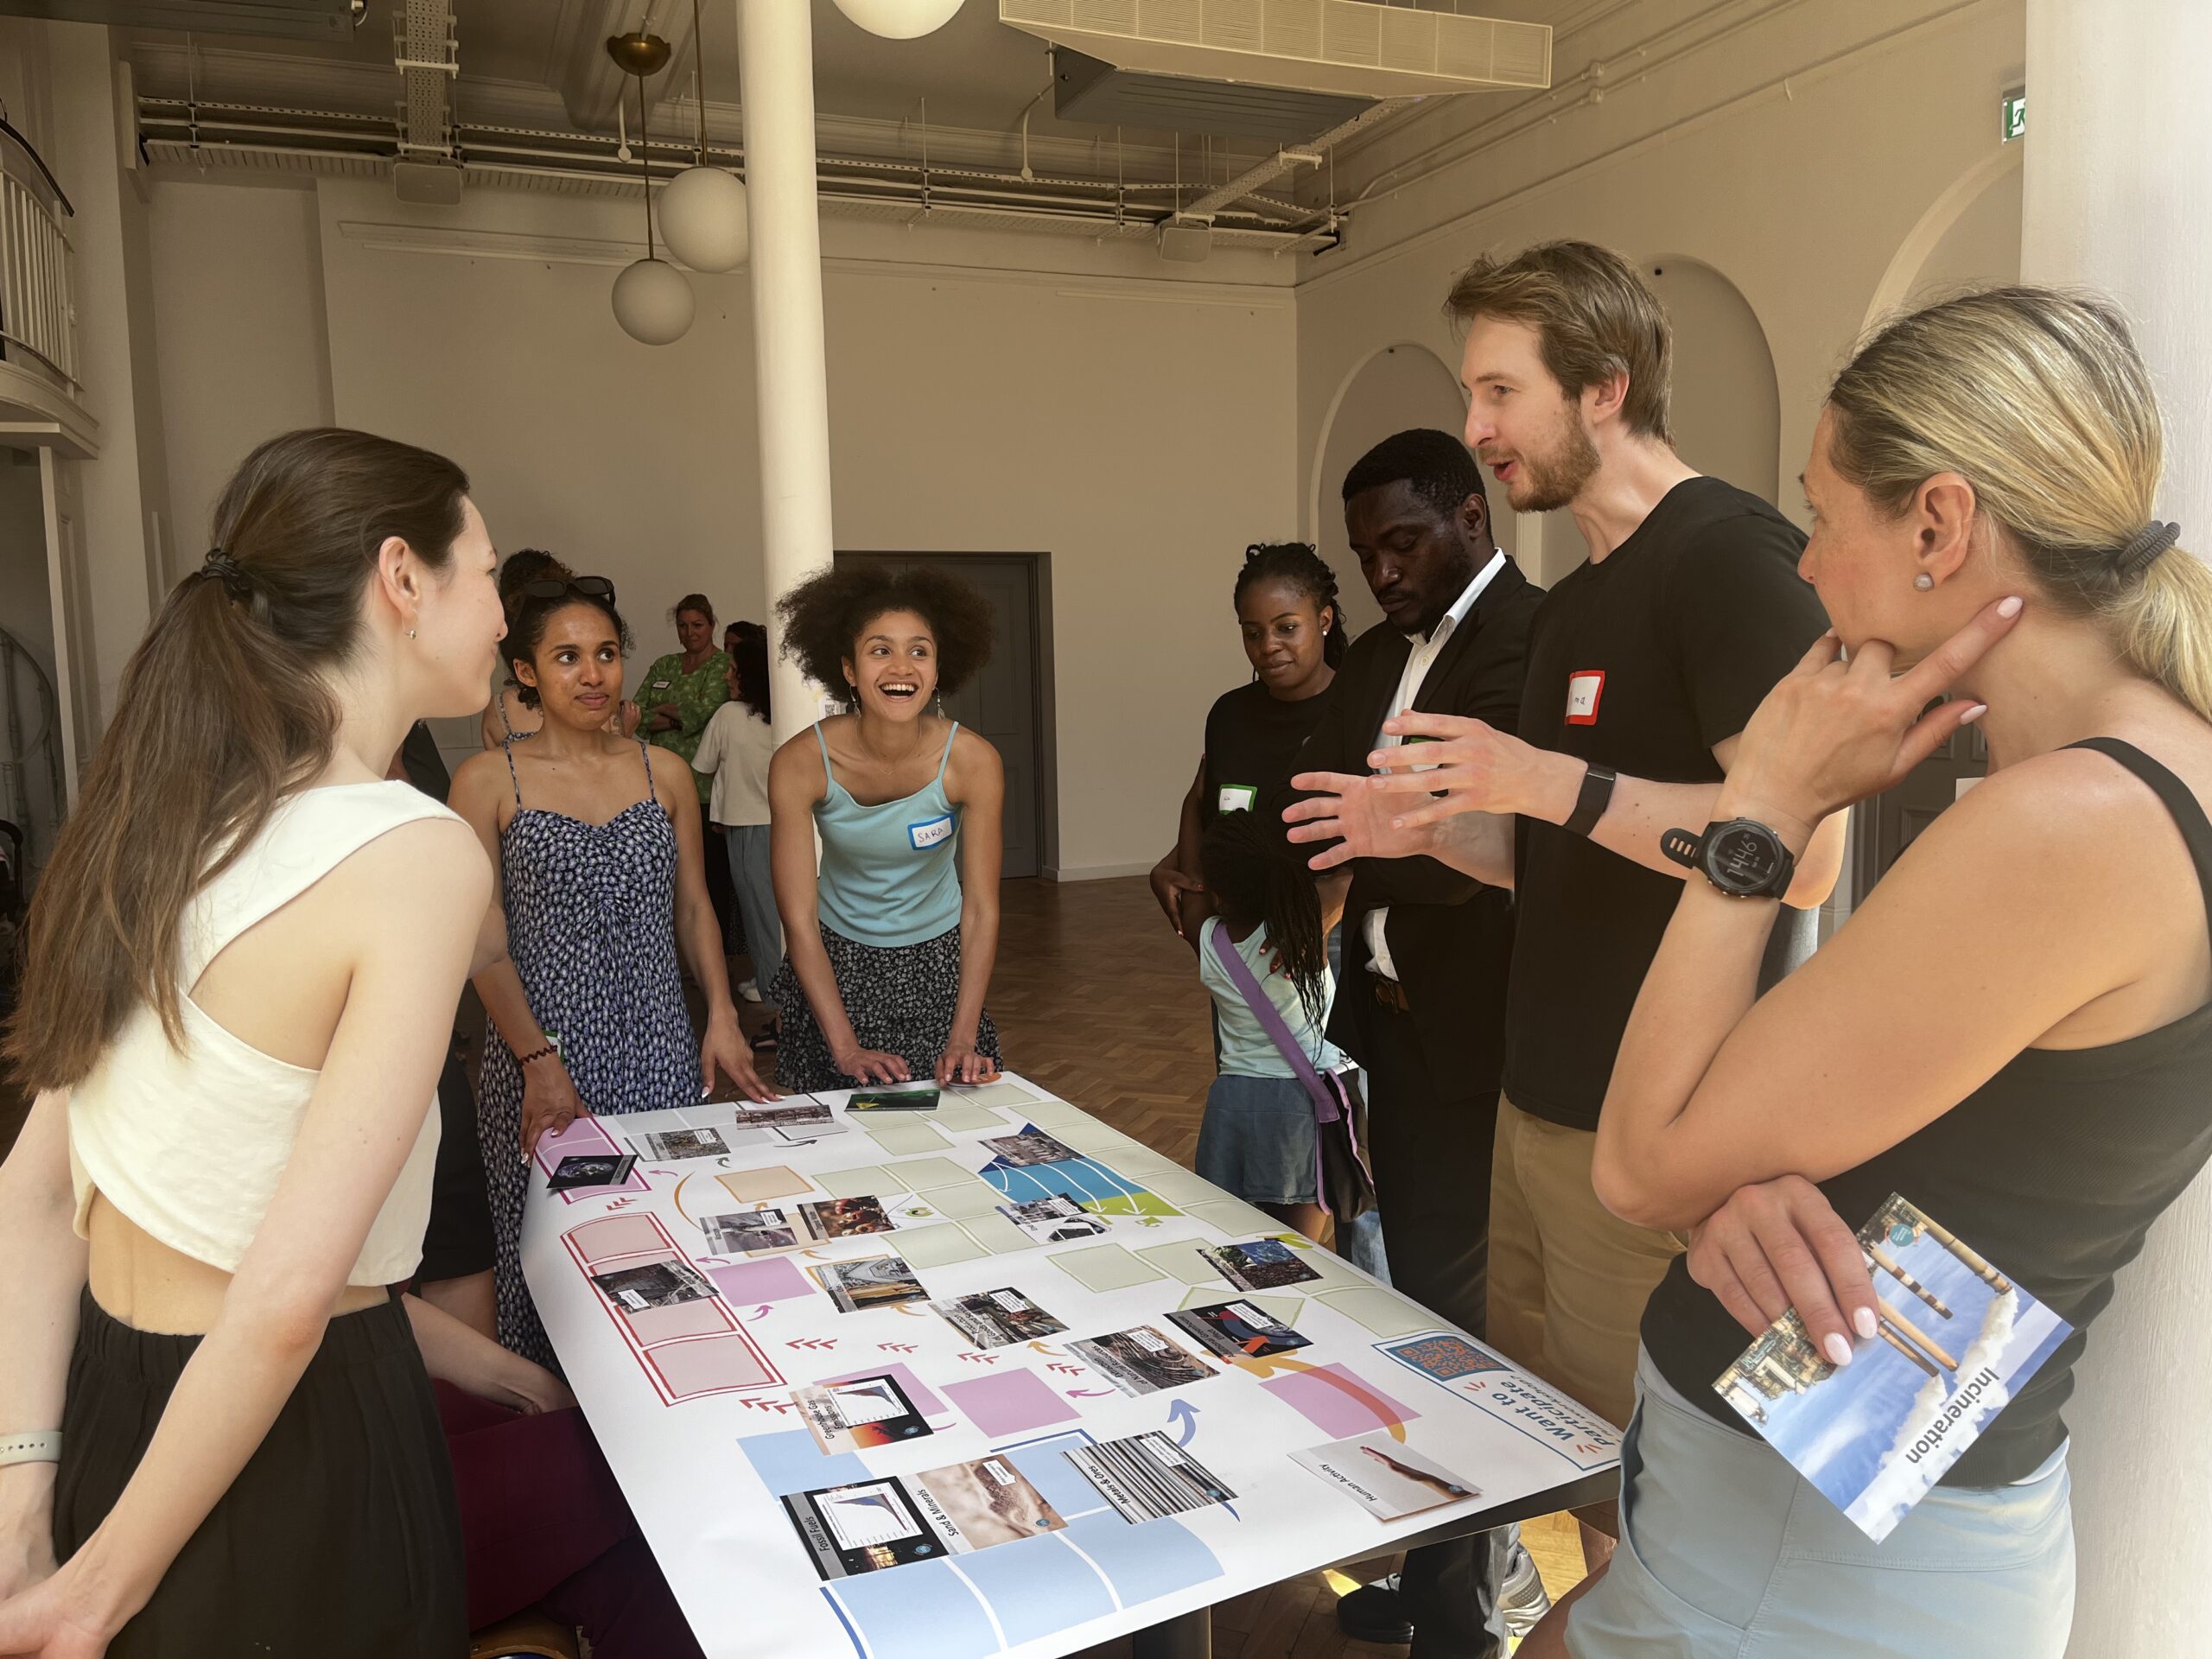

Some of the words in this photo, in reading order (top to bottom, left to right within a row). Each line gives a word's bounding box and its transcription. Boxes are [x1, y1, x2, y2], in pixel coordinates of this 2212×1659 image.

[918, 828, 944, 842] SARA
[1727, 841, 1757, 876] 1446
[1089, 1344, 1122, 1365] Resources
[1091, 1357, 1124, 1377] Extraction
[1115, 1364, 1141, 1380] Natural
[804, 1399, 818, 1409] Gas
[1491, 1393, 1516, 1406] to
[809, 1408, 836, 1439] Greenhouse
[822, 1405, 845, 1429] Emissions
[1500, 1381, 1616, 1446] Participate
[1515, 1406, 1575, 1441] Want
[1905, 1367, 2000, 1465] Incineration
[1085, 1465, 1106, 1479] Ores
[1315, 1463, 1351, 1483] Activity
[915, 1489, 942, 1514] Minerals
[1103, 1483, 1131, 1503] Metals
[1343, 1482, 1378, 1501] Human
[803, 1516, 820, 1533] Fuels
[939, 1520, 959, 1536] Sand
[811, 1532, 830, 1551] Fossil
